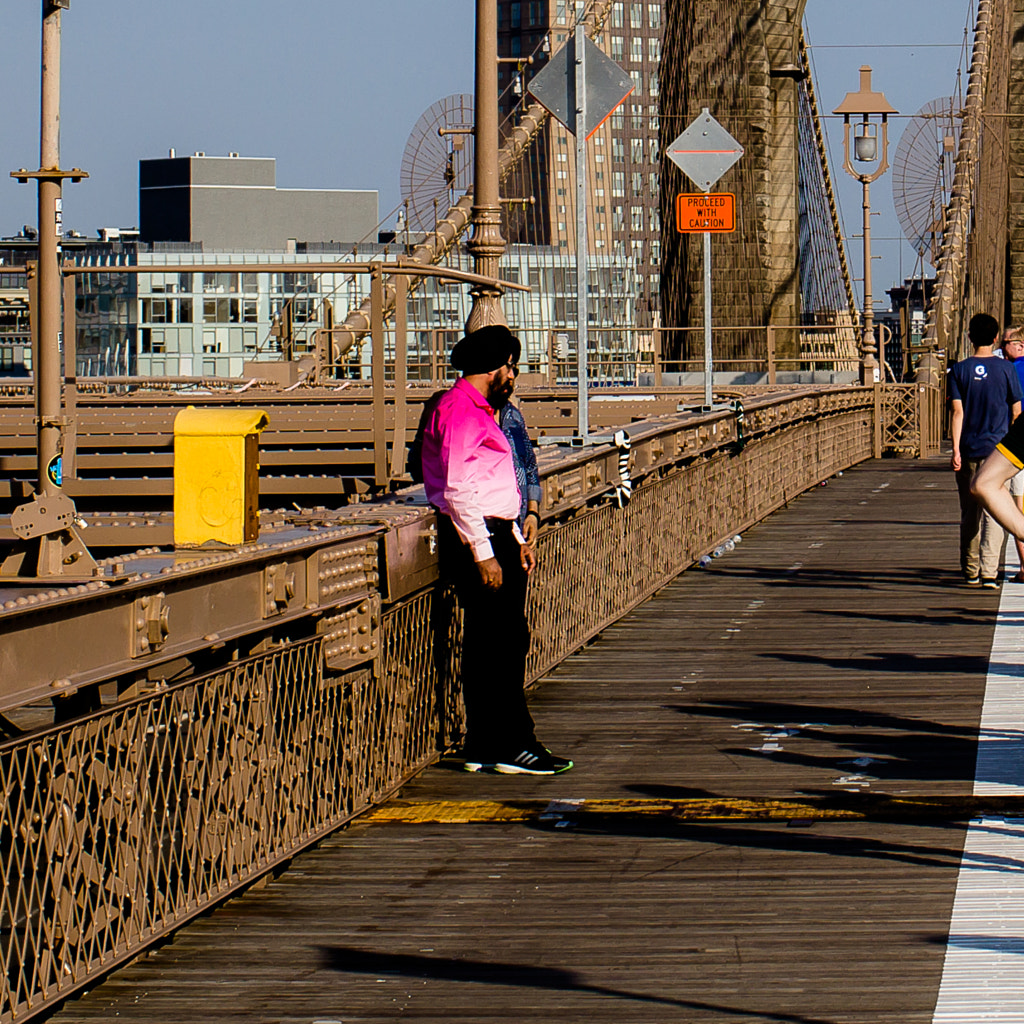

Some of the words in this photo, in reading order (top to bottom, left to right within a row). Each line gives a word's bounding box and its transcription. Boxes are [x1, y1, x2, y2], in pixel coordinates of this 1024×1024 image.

[688, 198, 725, 207] PROCEED
[697, 209, 717, 217] WITH
[689, 219, 724, 228] CAUTION
